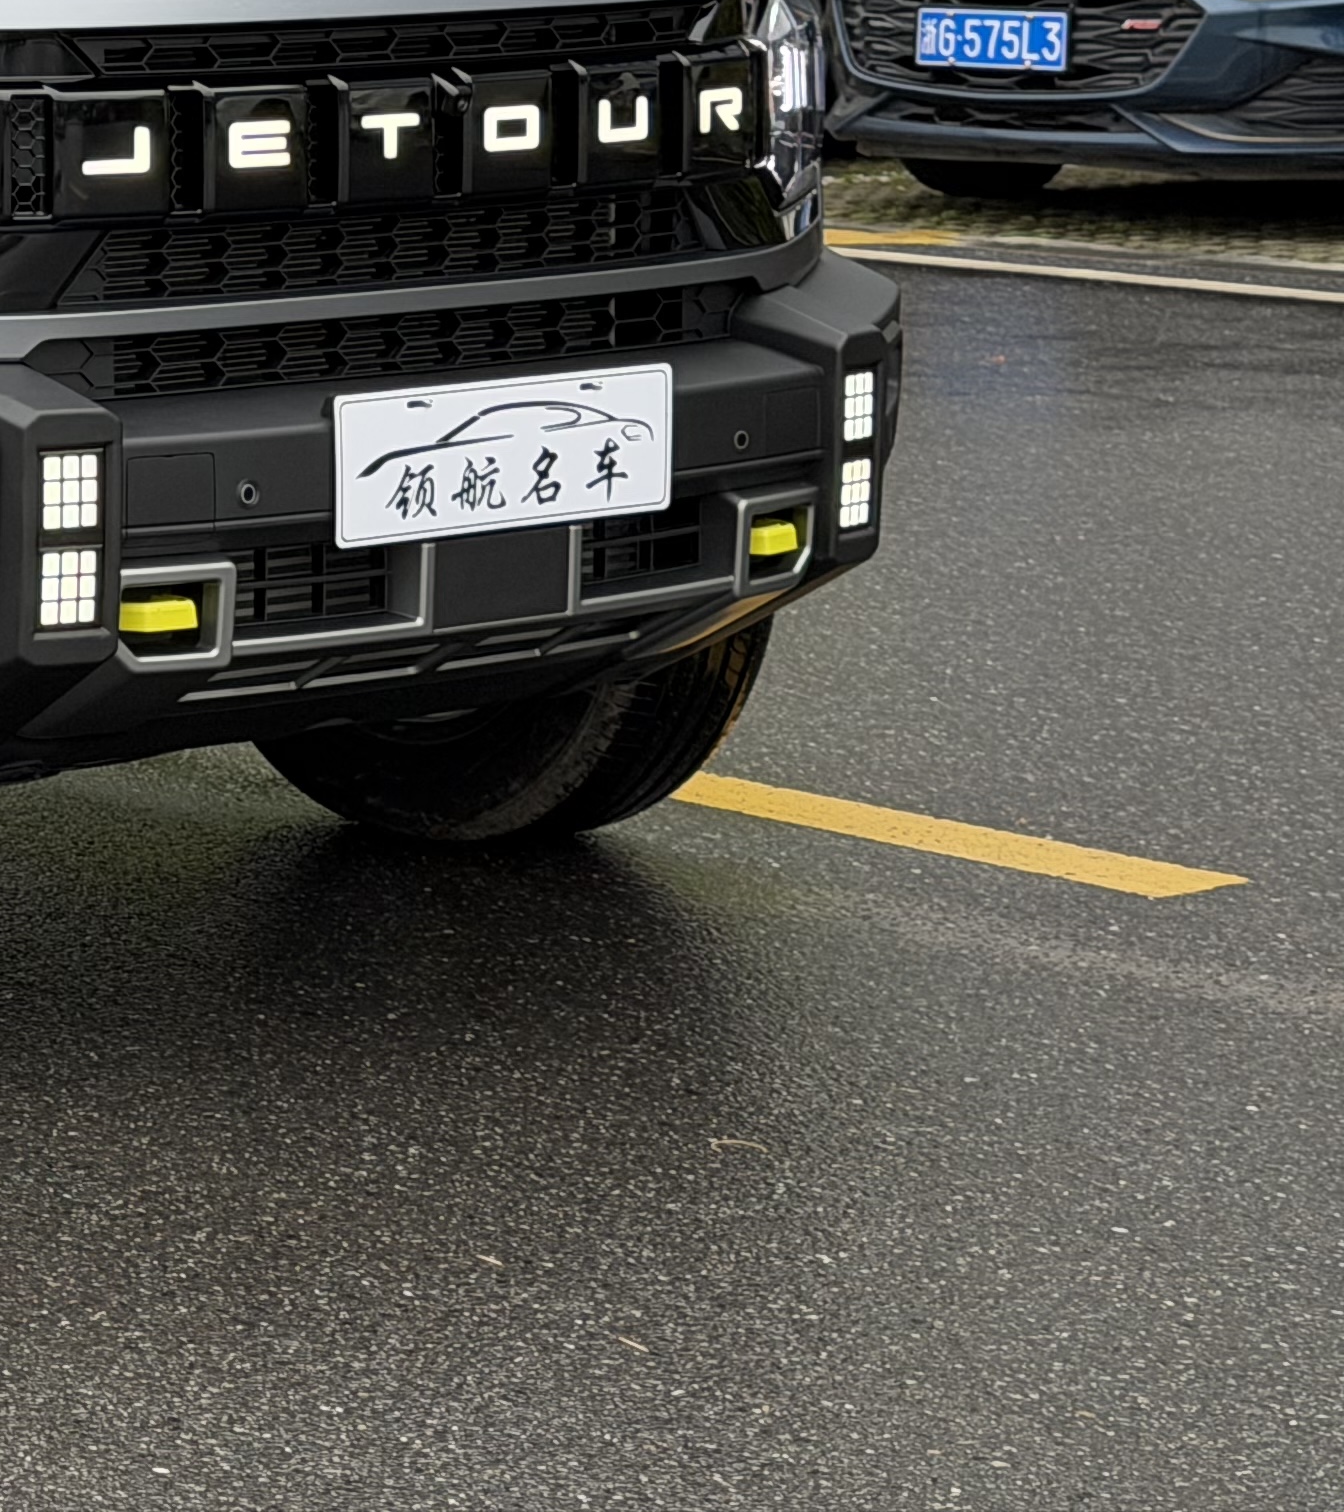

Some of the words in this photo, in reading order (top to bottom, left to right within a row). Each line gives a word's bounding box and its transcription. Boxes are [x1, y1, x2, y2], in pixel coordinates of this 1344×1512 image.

[81, 85, 742, 176] JETOUR
[385, 437, 629, 520] 领航名车
